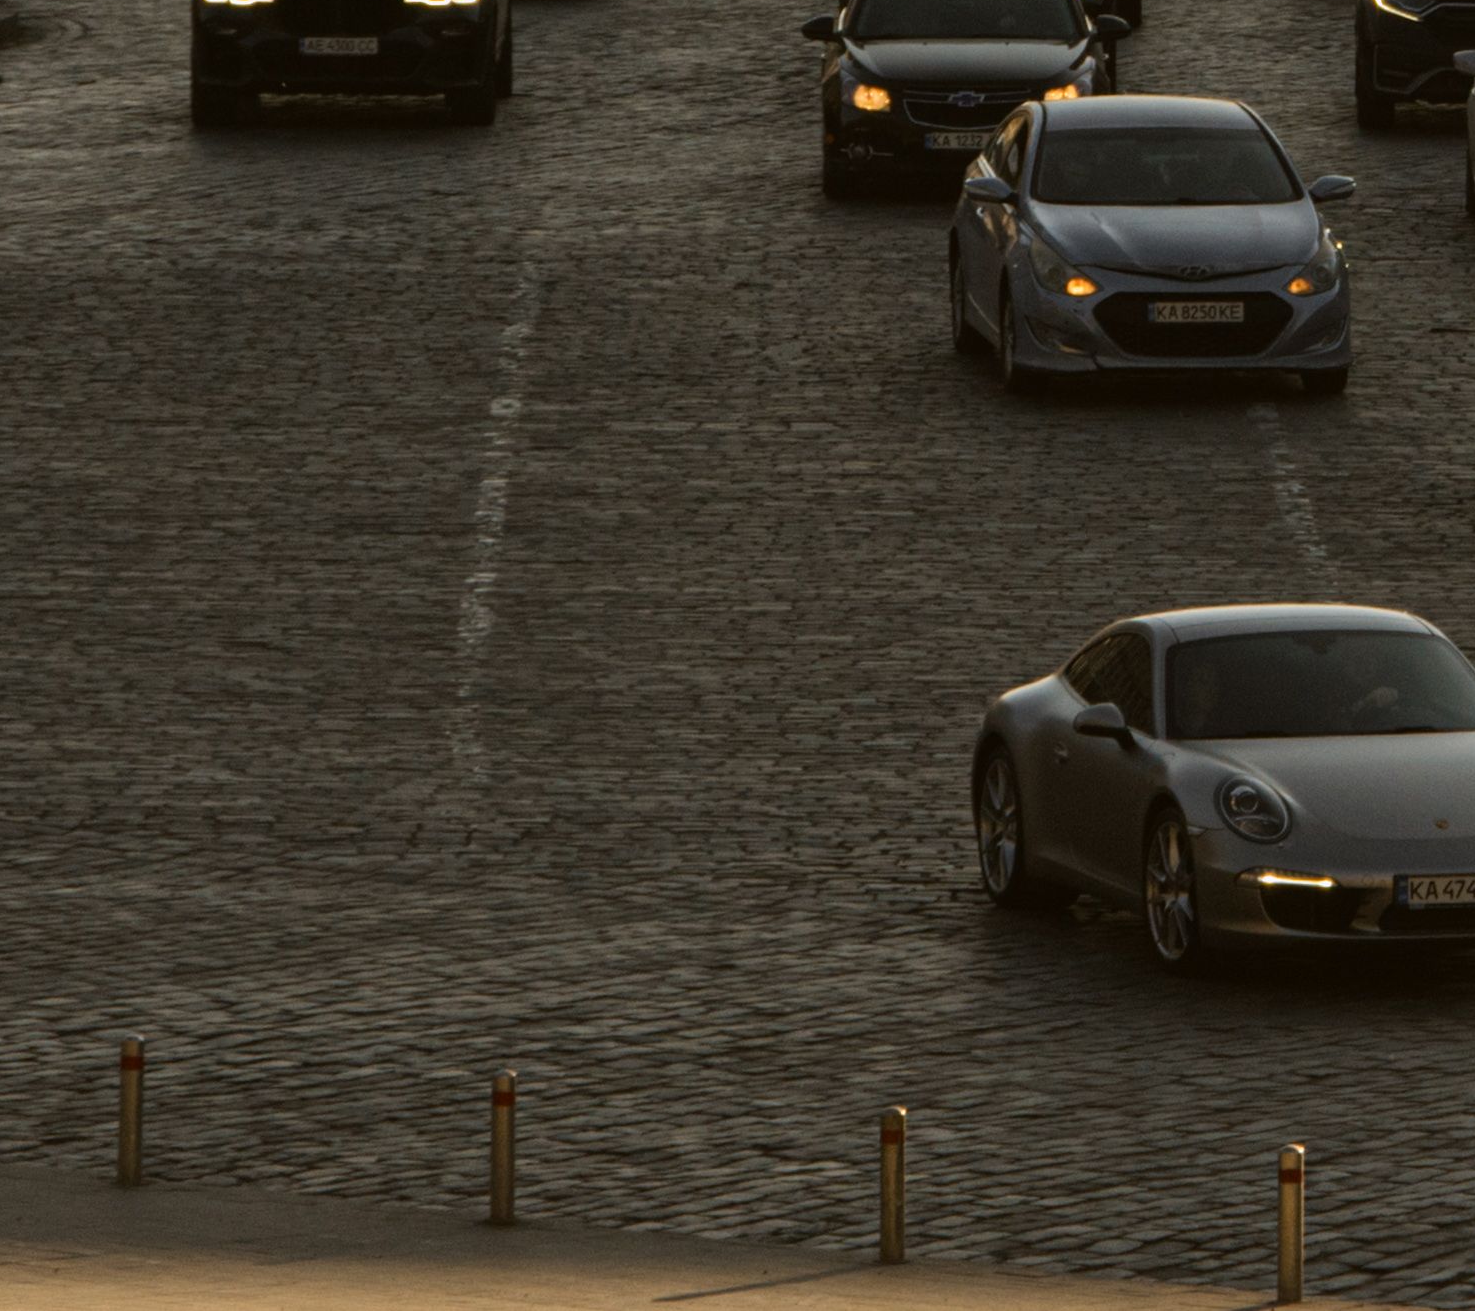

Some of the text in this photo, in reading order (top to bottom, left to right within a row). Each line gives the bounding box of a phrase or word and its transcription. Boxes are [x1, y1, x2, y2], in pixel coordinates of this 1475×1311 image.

[932, 135, 950, 147] KA
[1156, 305, 1242, 322] KA 8250 KE
[1409, 880, 1438, 901] KA
